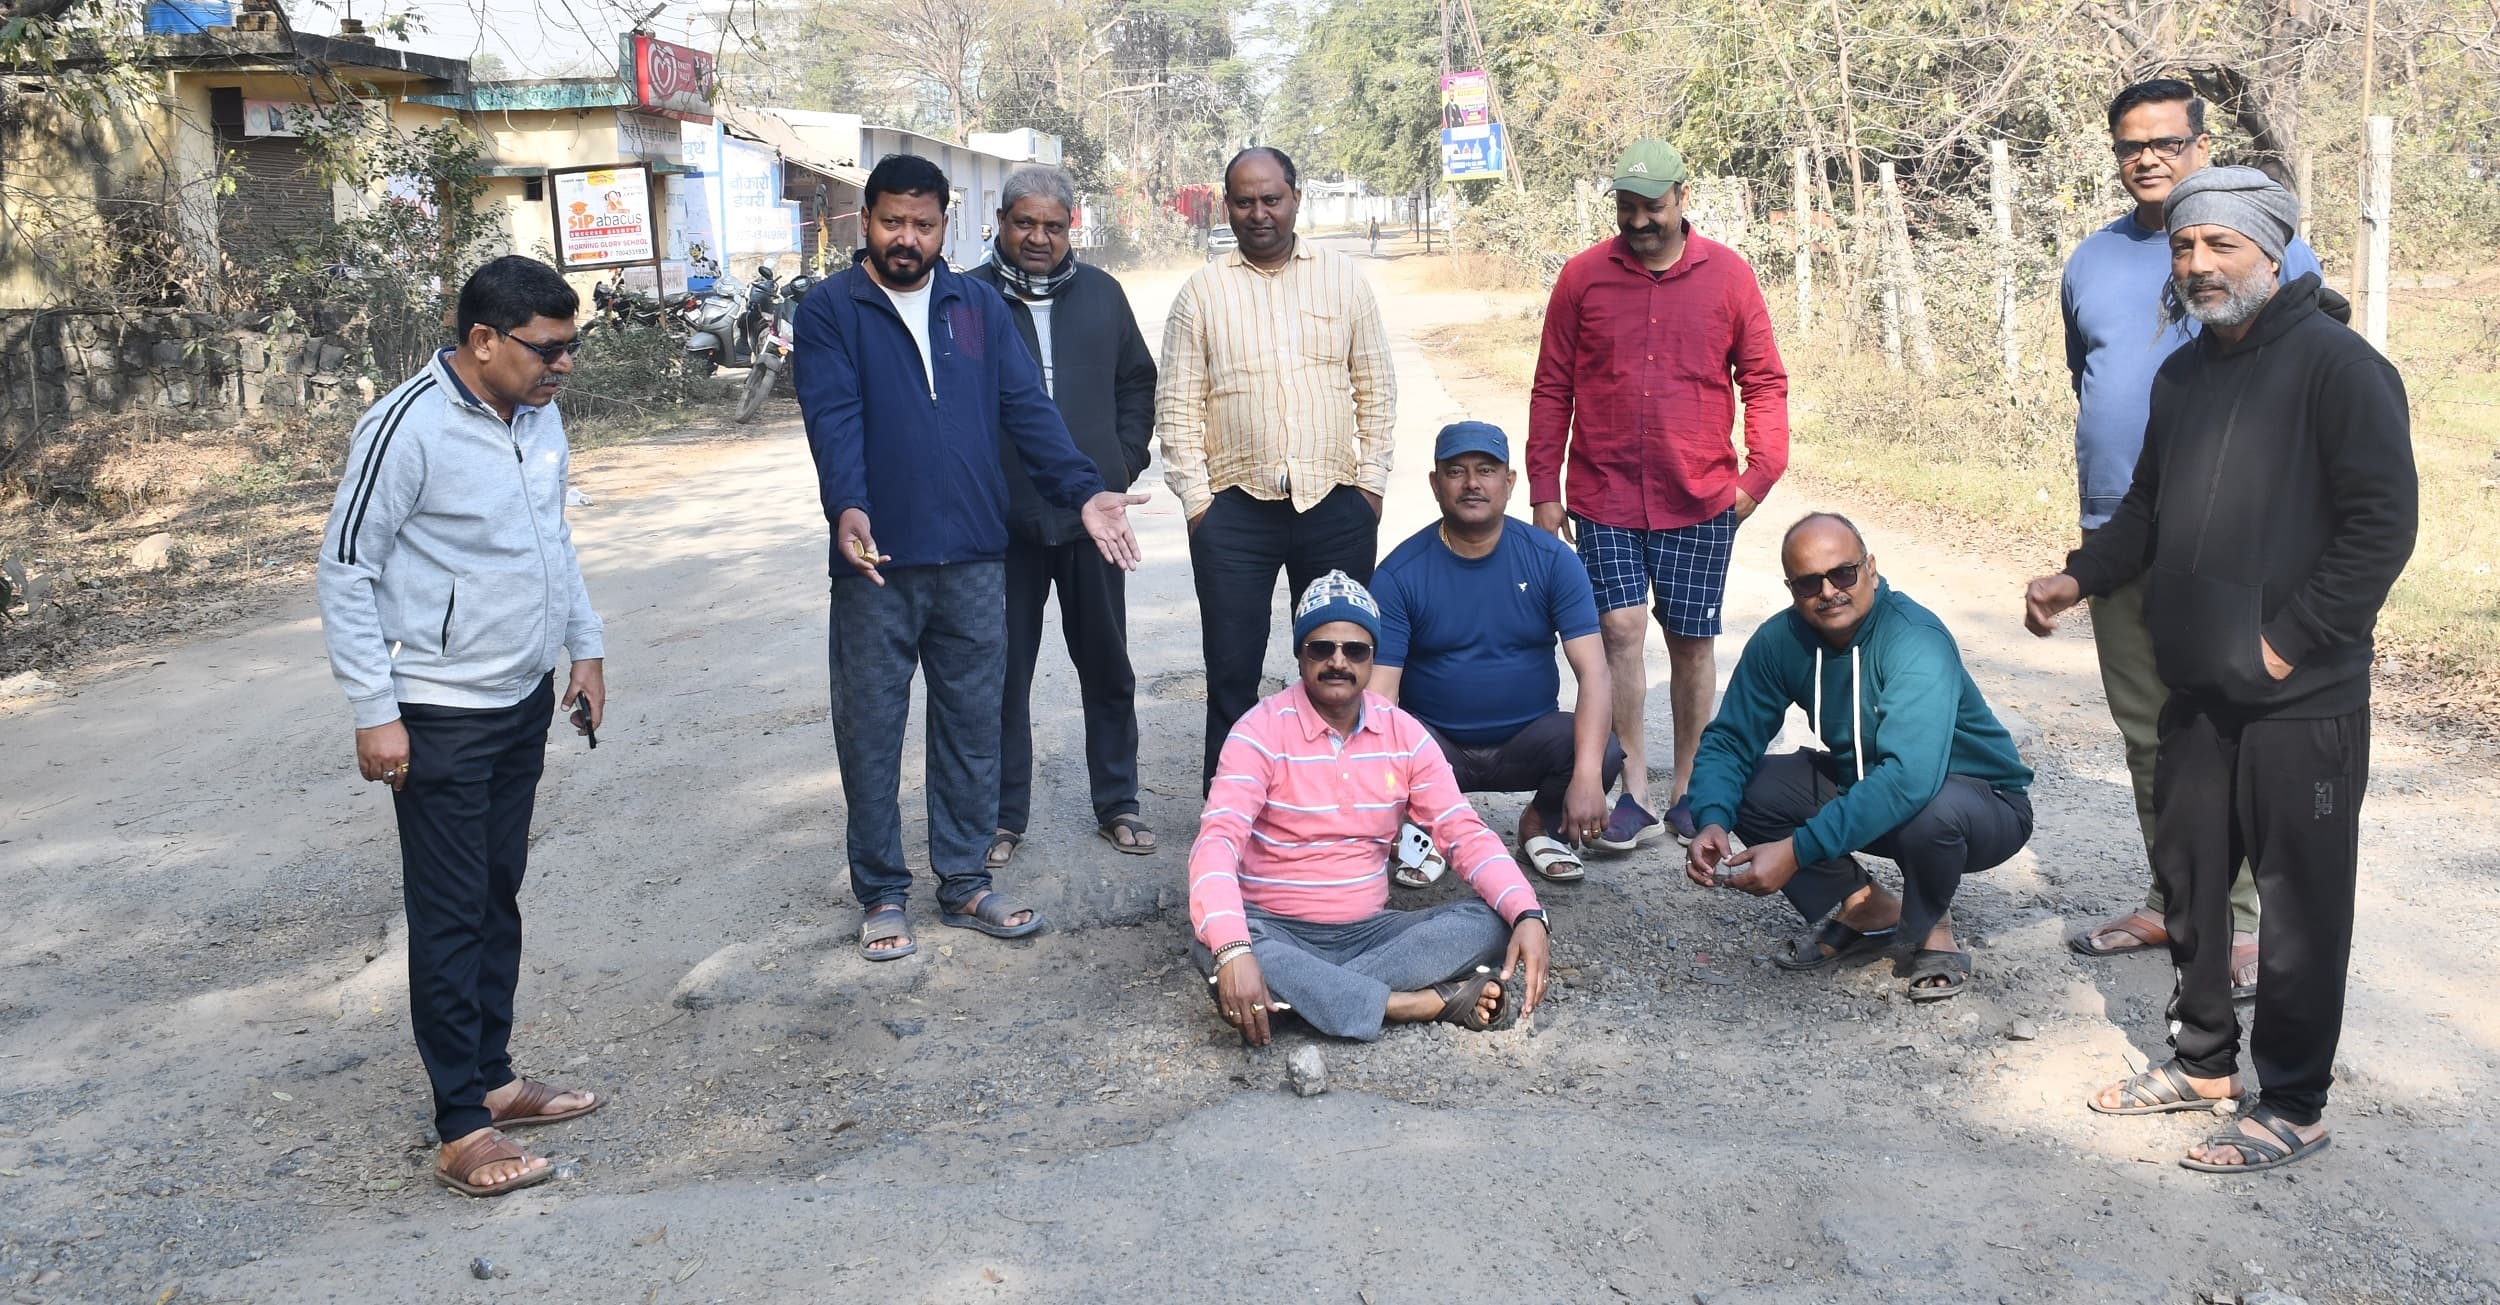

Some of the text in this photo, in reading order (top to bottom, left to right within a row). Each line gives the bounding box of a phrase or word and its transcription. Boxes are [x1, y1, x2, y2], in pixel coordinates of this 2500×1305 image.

[596, 211, 642, 228] abacus
[568, 241, 599, 250] MORNING
[600, 240, 621, 248] GLORY
[623, 238, 648, 247] SCHOOL
